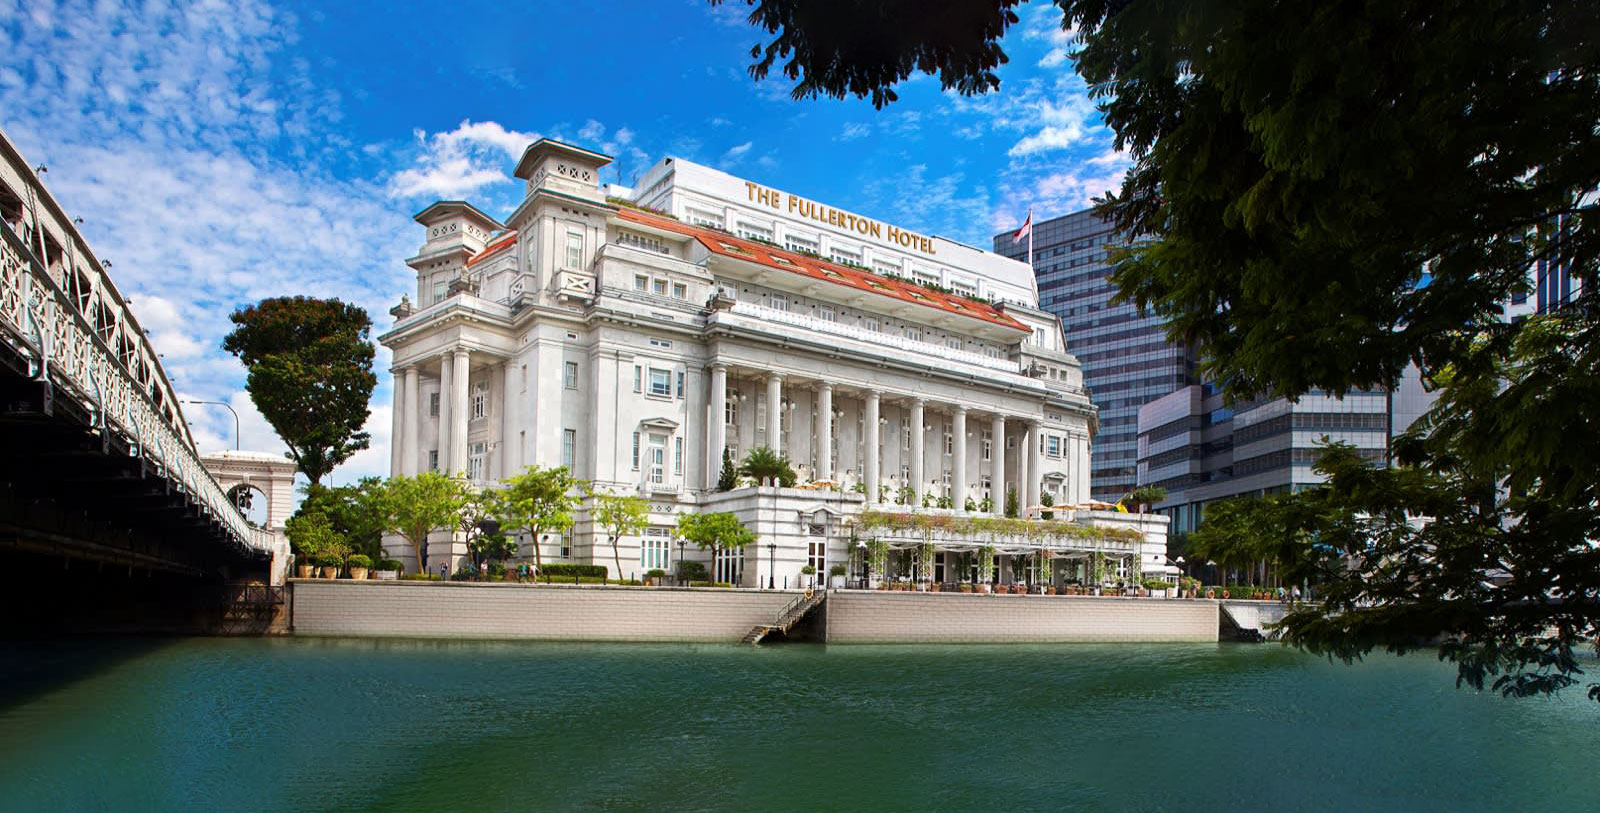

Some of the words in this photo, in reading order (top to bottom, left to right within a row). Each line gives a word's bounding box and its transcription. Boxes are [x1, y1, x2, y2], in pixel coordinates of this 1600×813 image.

[745, 182, 780, 209] THE
[788, 194, 881, 240] FULLERTON
[887, 226, 936, 255] HOTEL
